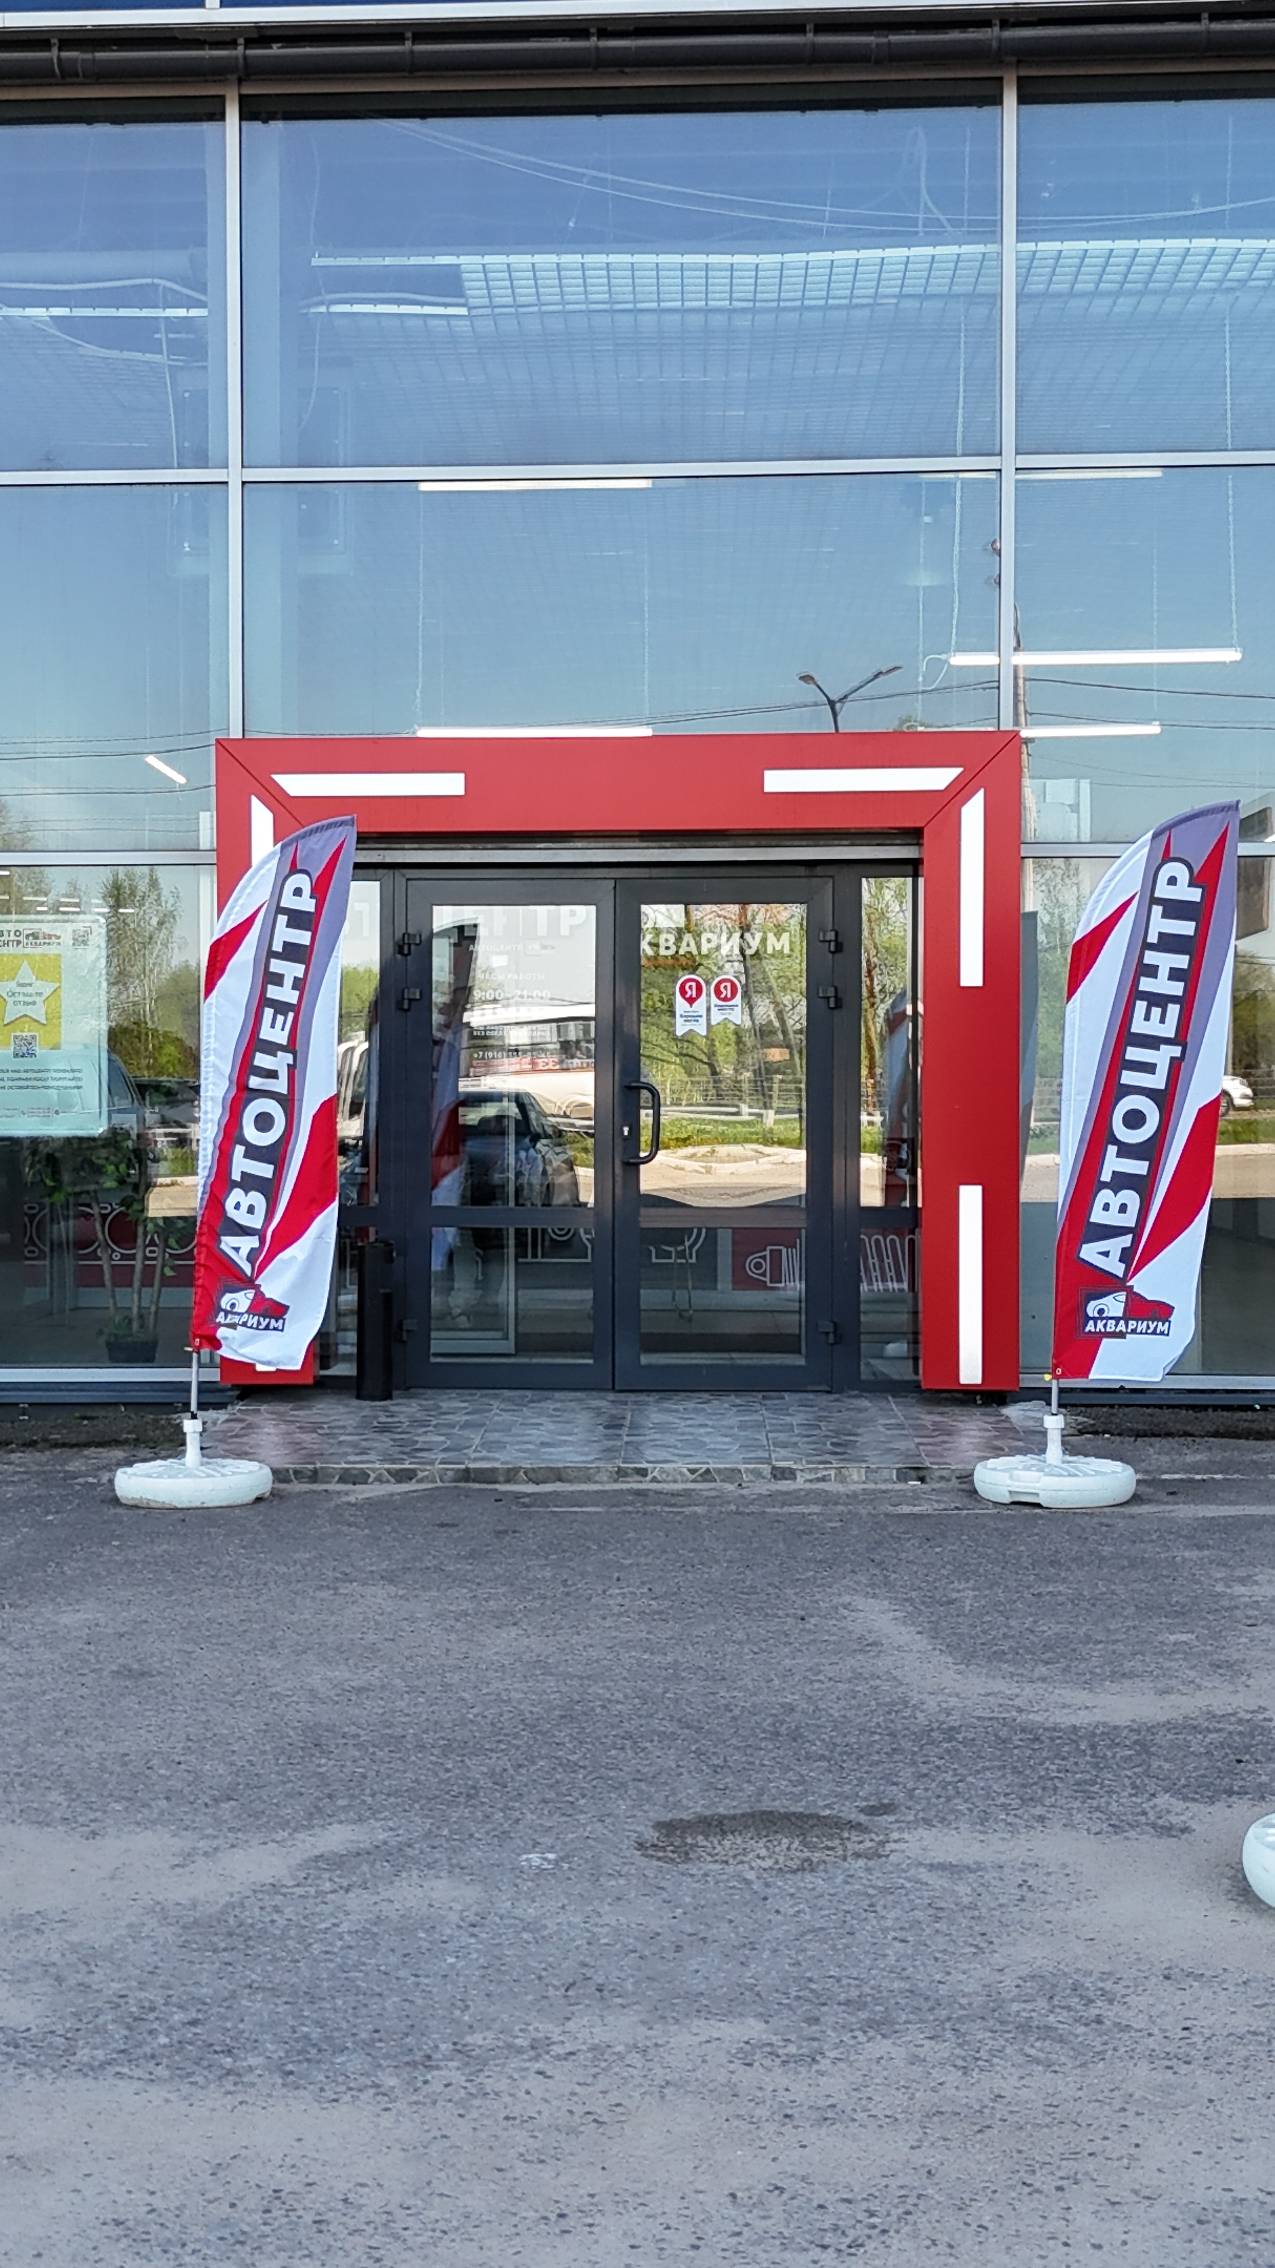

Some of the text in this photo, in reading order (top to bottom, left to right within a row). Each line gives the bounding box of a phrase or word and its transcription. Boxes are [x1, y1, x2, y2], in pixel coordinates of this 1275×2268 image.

[219, 872, 318, 1277] АВТОЦЕНТР
[1078, 860, 1203, 1278] АВТОЦЕНТР
[215, 1311, 284, 1330] АРИУМ
[1083, 1319, 1170, 1335] АКВАРИУМ
